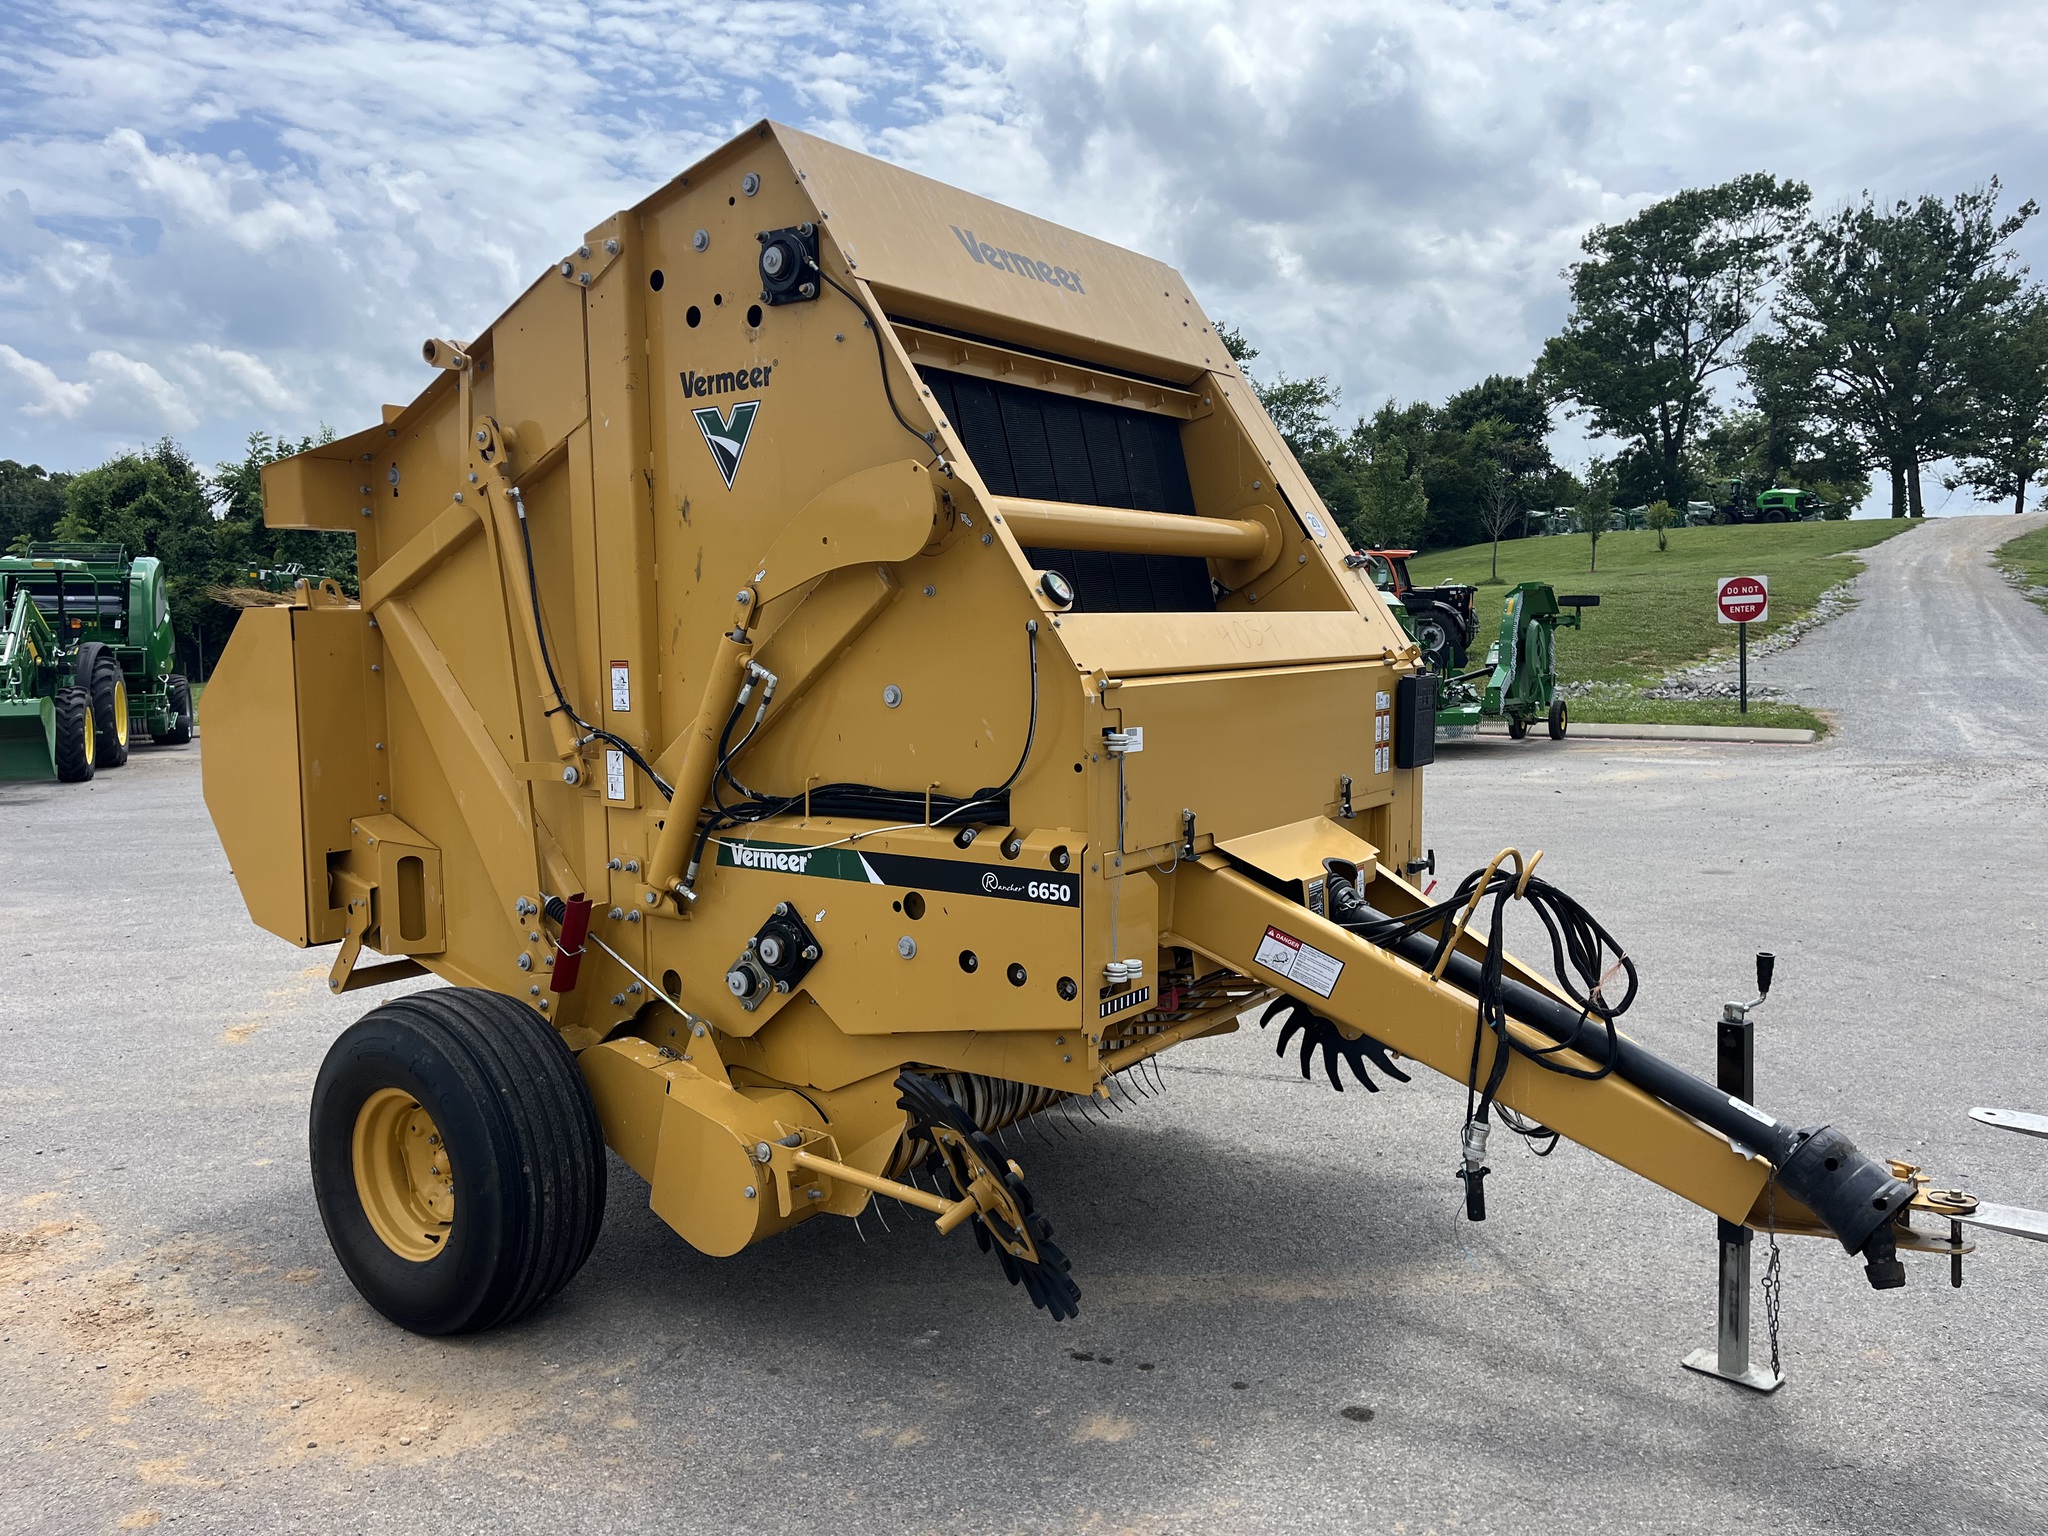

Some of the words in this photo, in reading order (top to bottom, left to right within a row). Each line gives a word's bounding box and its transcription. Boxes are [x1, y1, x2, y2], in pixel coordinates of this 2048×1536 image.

[949, 224, 1086, 295] Vermeer
[679, 366, 772, 399] Vermeer
[1727, 586, 1739, 595] DO
[1742, 585, 1759, 594] NOT
[1729, 605, 1756, 614] ENTER
[731, 843, 808, 873] Vermeer
[1027, 881, 1071, 902] 6650
[1275, 933, 1300, 949] DANGER
